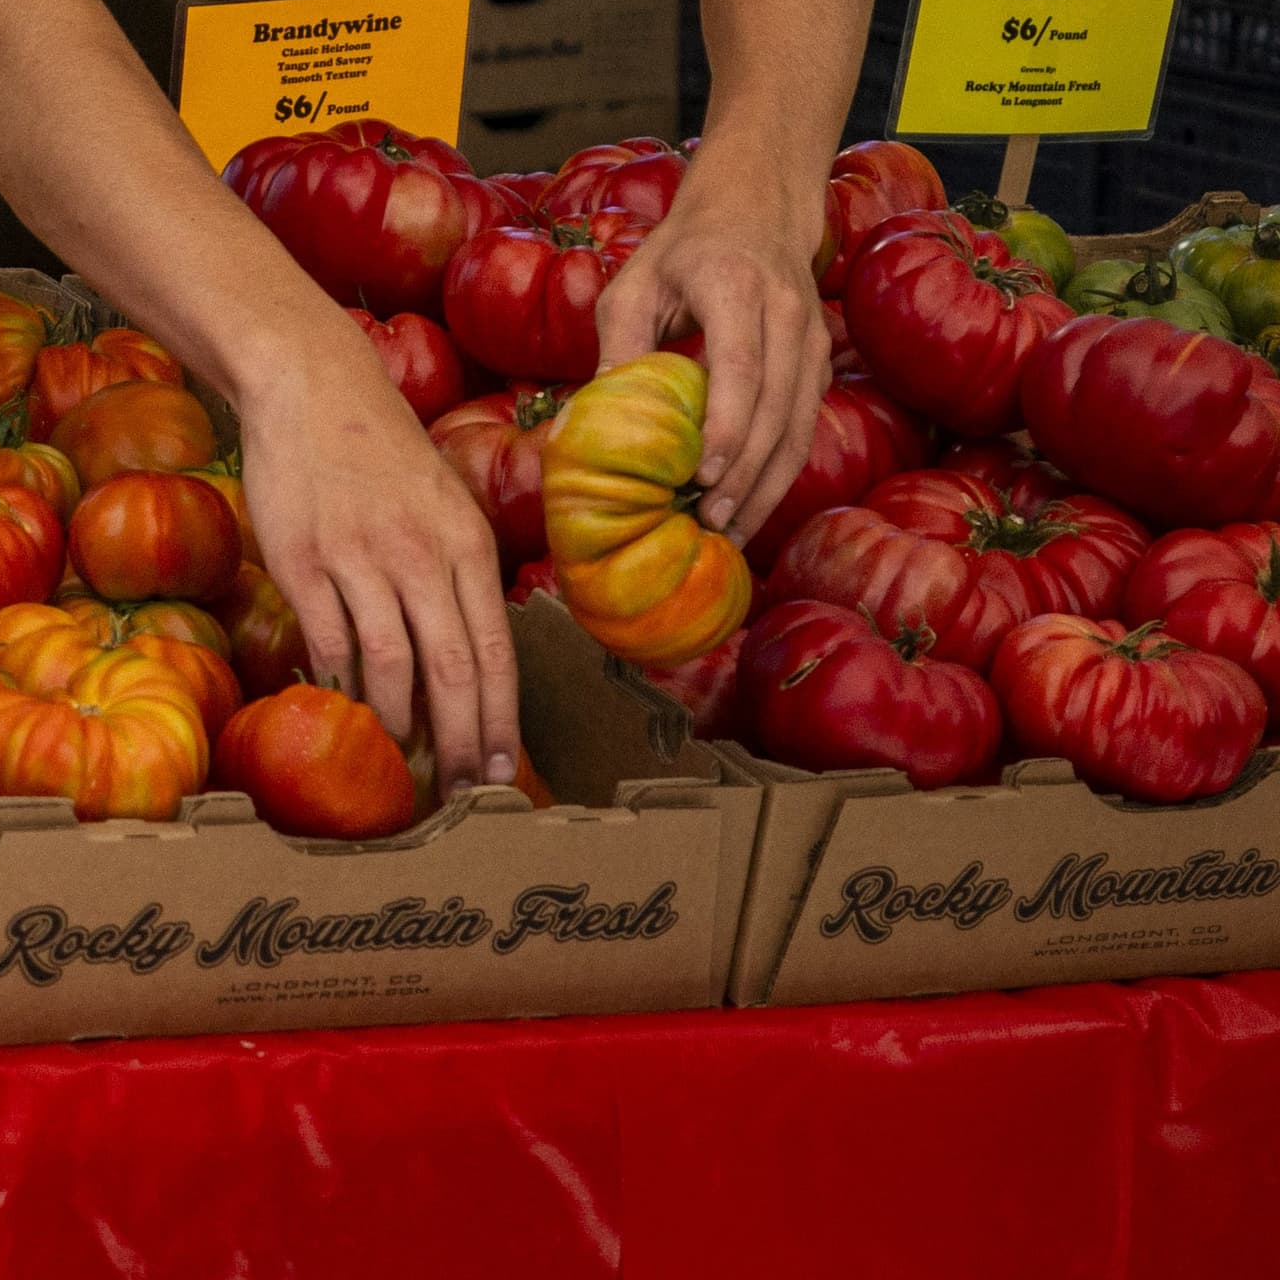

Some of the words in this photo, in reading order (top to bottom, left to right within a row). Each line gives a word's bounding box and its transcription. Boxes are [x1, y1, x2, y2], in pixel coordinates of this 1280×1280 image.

[252, 13, 402, 43] Brandywine
[281, 45, 319, 58] Classic
[321, 41, 371, 54] Heirloom
[277, 60, 311, 73] Tangy
[312, 57, 334, 70] and
[335, 54, 373, 68] Savory
[280, 72, 323, 85] Smooth
[325, 69, 367, 81] Texture
[965, 81, 1005, 94] Rocky
[1007, 81, 1066, 93] Mountain
[1067, 80, 1101, 92] Fresh
[1001, 96, 1012, 107] In
[1014, 97, 1063, 108] Longmont
[820, 860, 1012, 945] Rocky
[1014, 848, 1280, 922] Mountain
[196, 895, 493, 970] Mountain
[491, 881, 679, 954] Fresh
[1191, 924, 1222, 936] CO
[389, 973, 422, 985] CO
